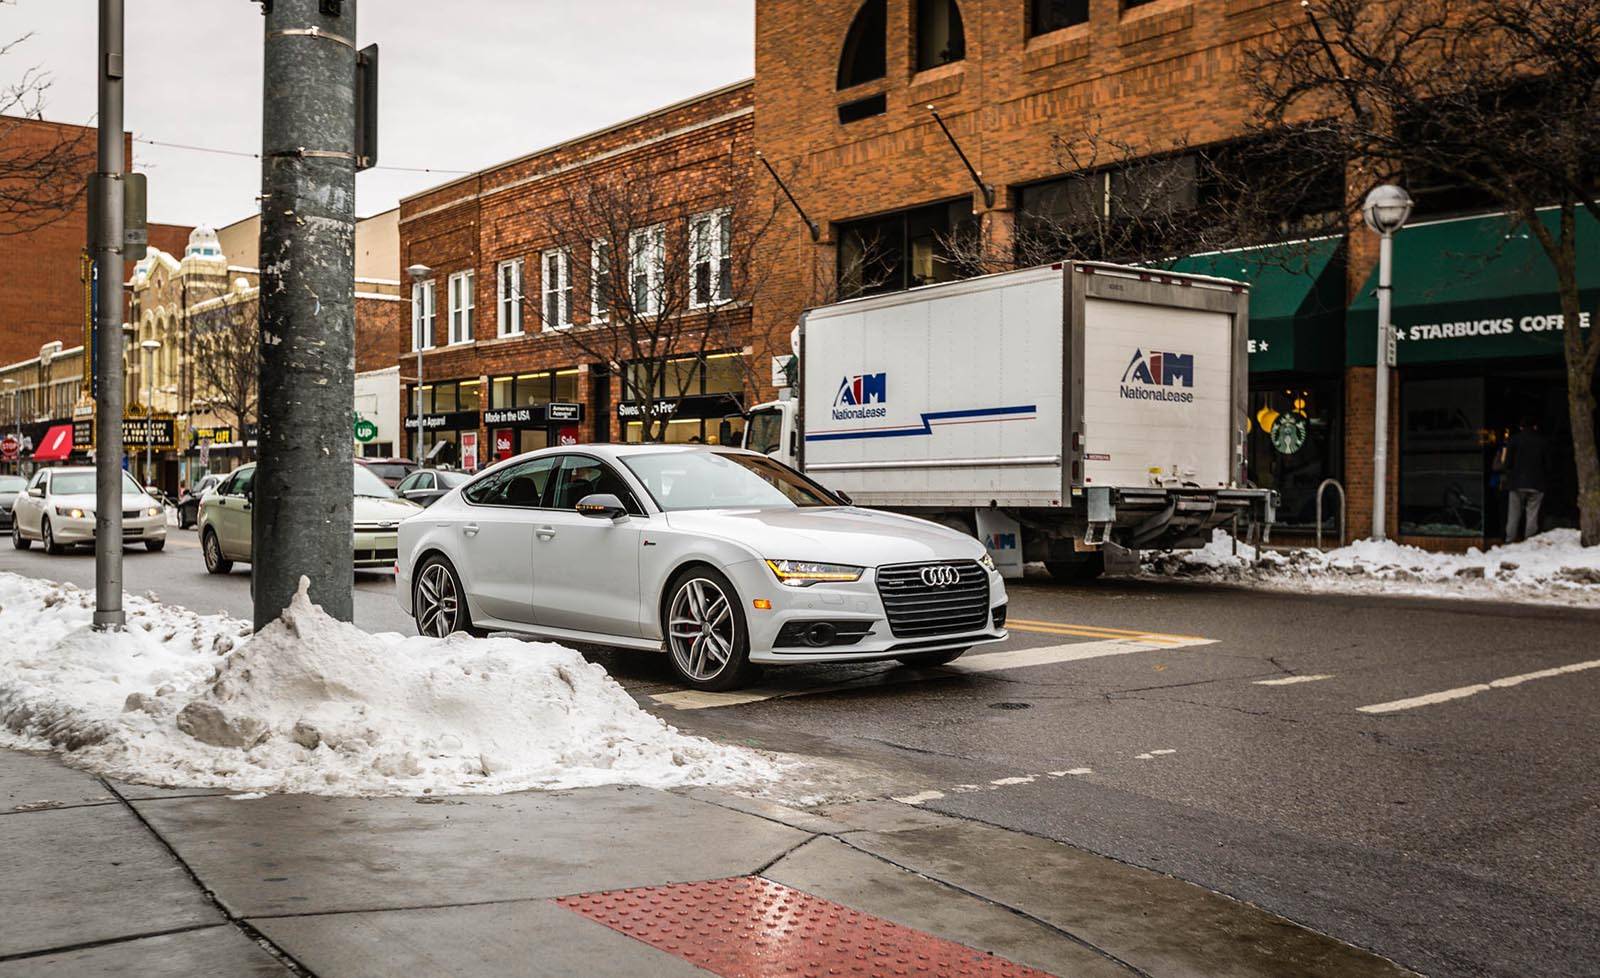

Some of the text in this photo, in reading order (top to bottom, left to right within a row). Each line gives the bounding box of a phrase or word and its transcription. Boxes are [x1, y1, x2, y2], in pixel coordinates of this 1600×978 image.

[1410, 312, 1591, 341] STARBUCKS COFFE
[1121, 348, 1194, 387] AIM
[832, 372, 887, 407] AIM
[1119, 385, 1194, 403] NationaLease
[485, 409, 531, 423] Made in the USA
[831, 407, 887, 420] NationaLease
[357, 427, 373, 438] UP
[2, 442, 17, 450] STOP
[497, 438, 511, 450] Sale
